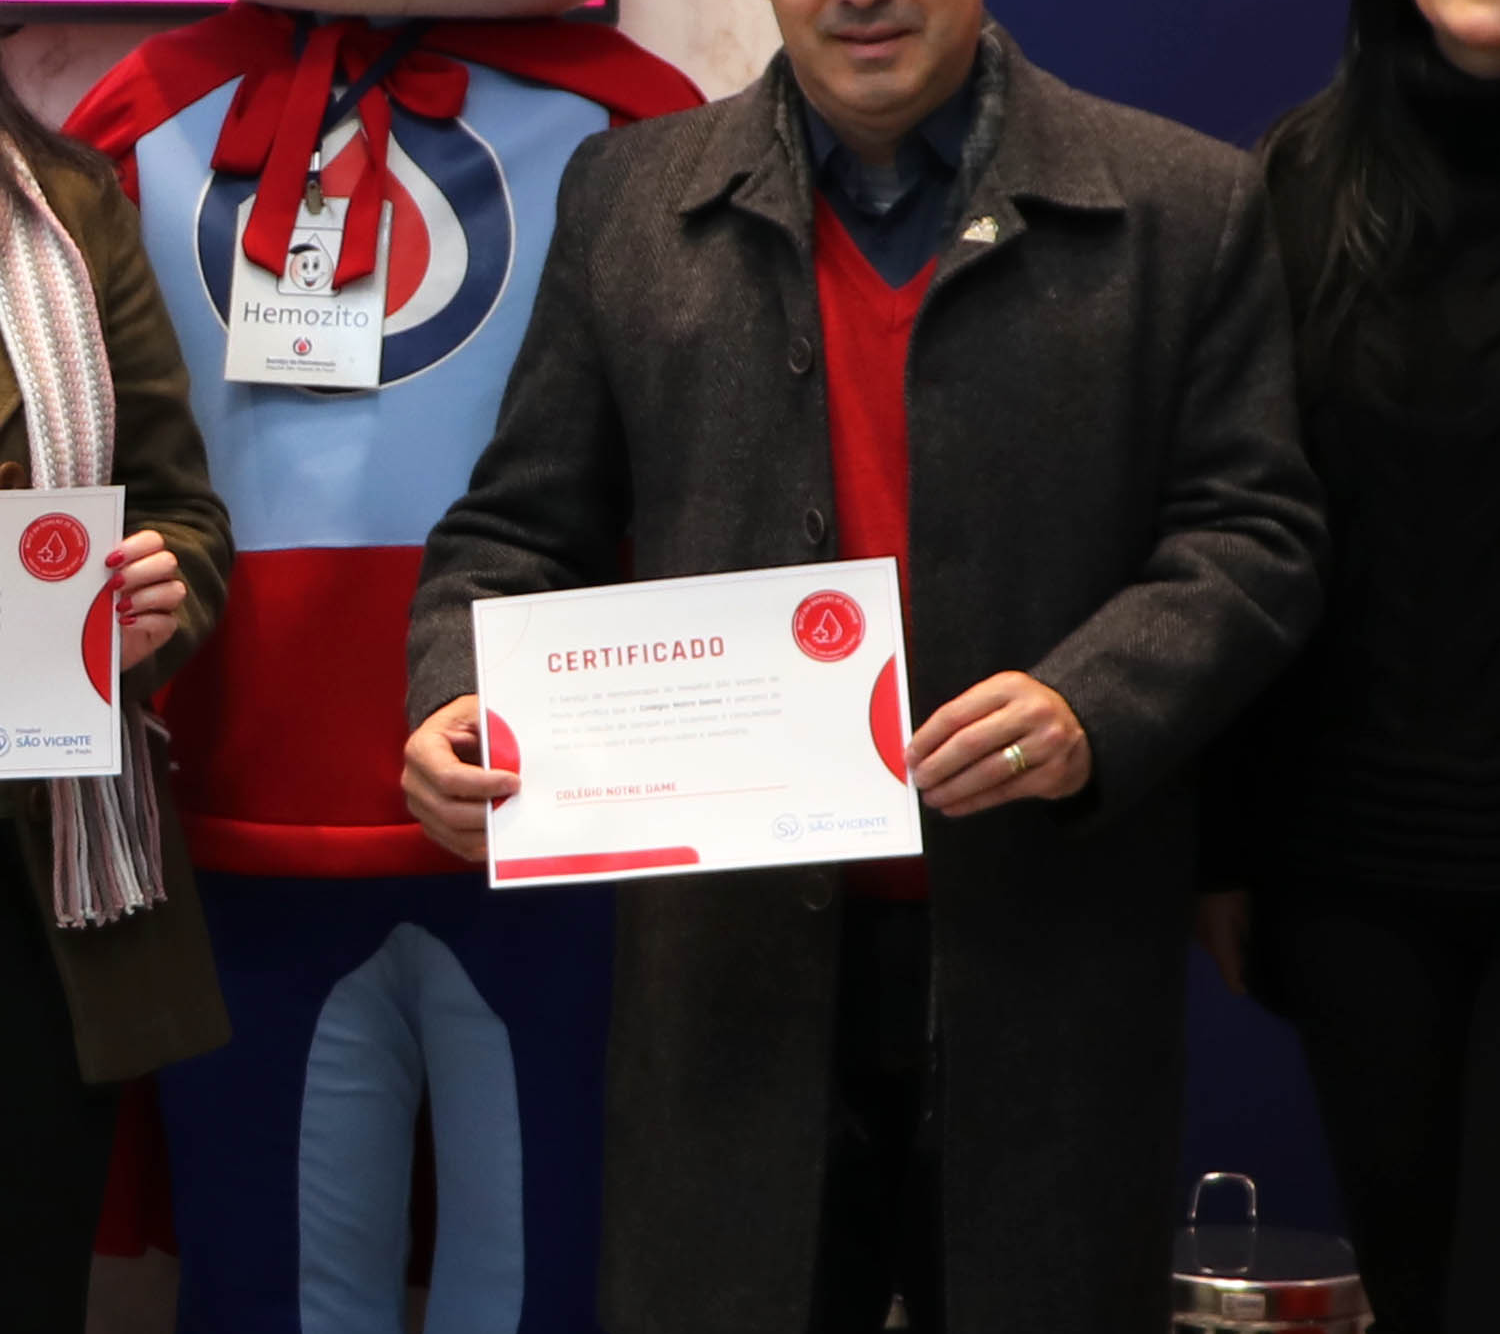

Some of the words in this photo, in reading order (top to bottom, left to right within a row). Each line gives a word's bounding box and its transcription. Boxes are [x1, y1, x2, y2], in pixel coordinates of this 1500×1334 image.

[243, 301, 369, 328] Hemozito
[547, 636, 725, 673] CERTIFICADO
[43, 734, 92, 747] VICENTE
